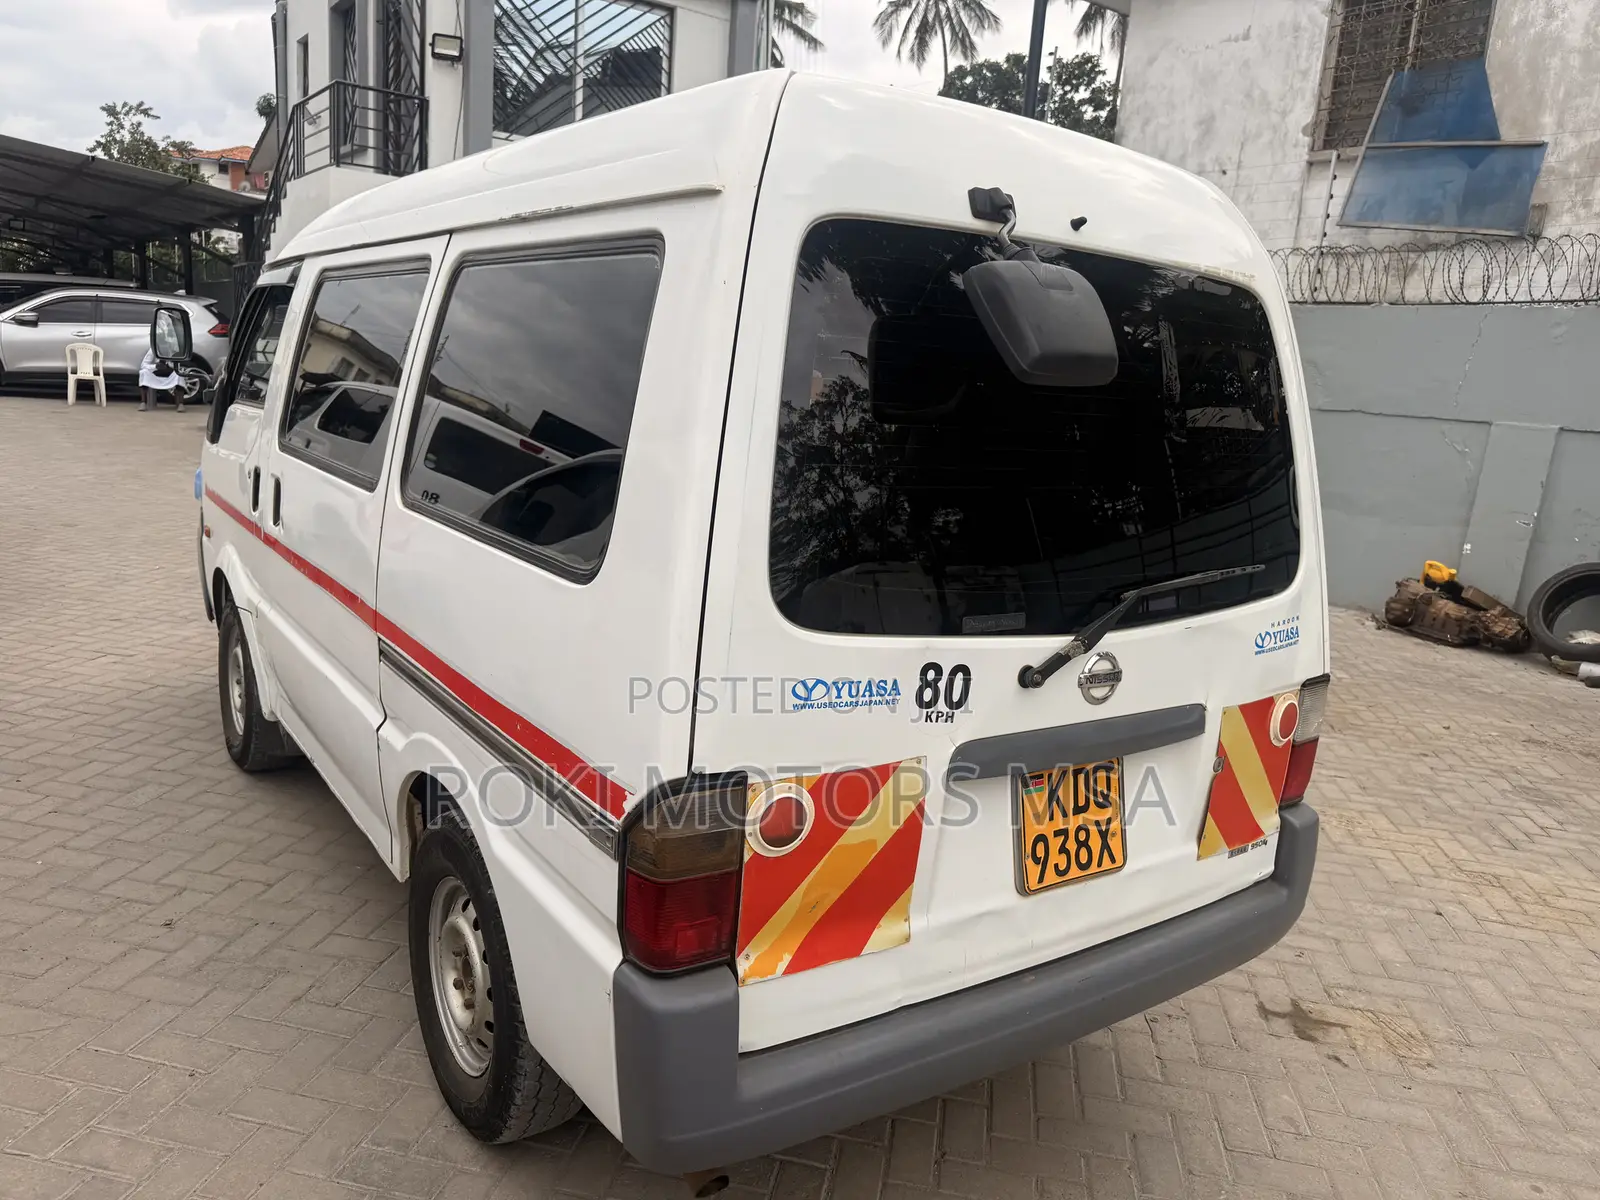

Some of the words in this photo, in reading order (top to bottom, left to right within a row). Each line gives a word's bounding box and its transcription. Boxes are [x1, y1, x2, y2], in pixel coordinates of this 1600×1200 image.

[1273, 626, 1299, 644] YUASA
[915, 661, 971, 710] 80
[1085, 672, 1119, 684] NISSAN
[832, 679, 901, 699] YUASA
[925, 711, 955, 723] KPH
[1047, 763, 1112, 821] KDQ
[1031, 817, 1116, 884] 938X
